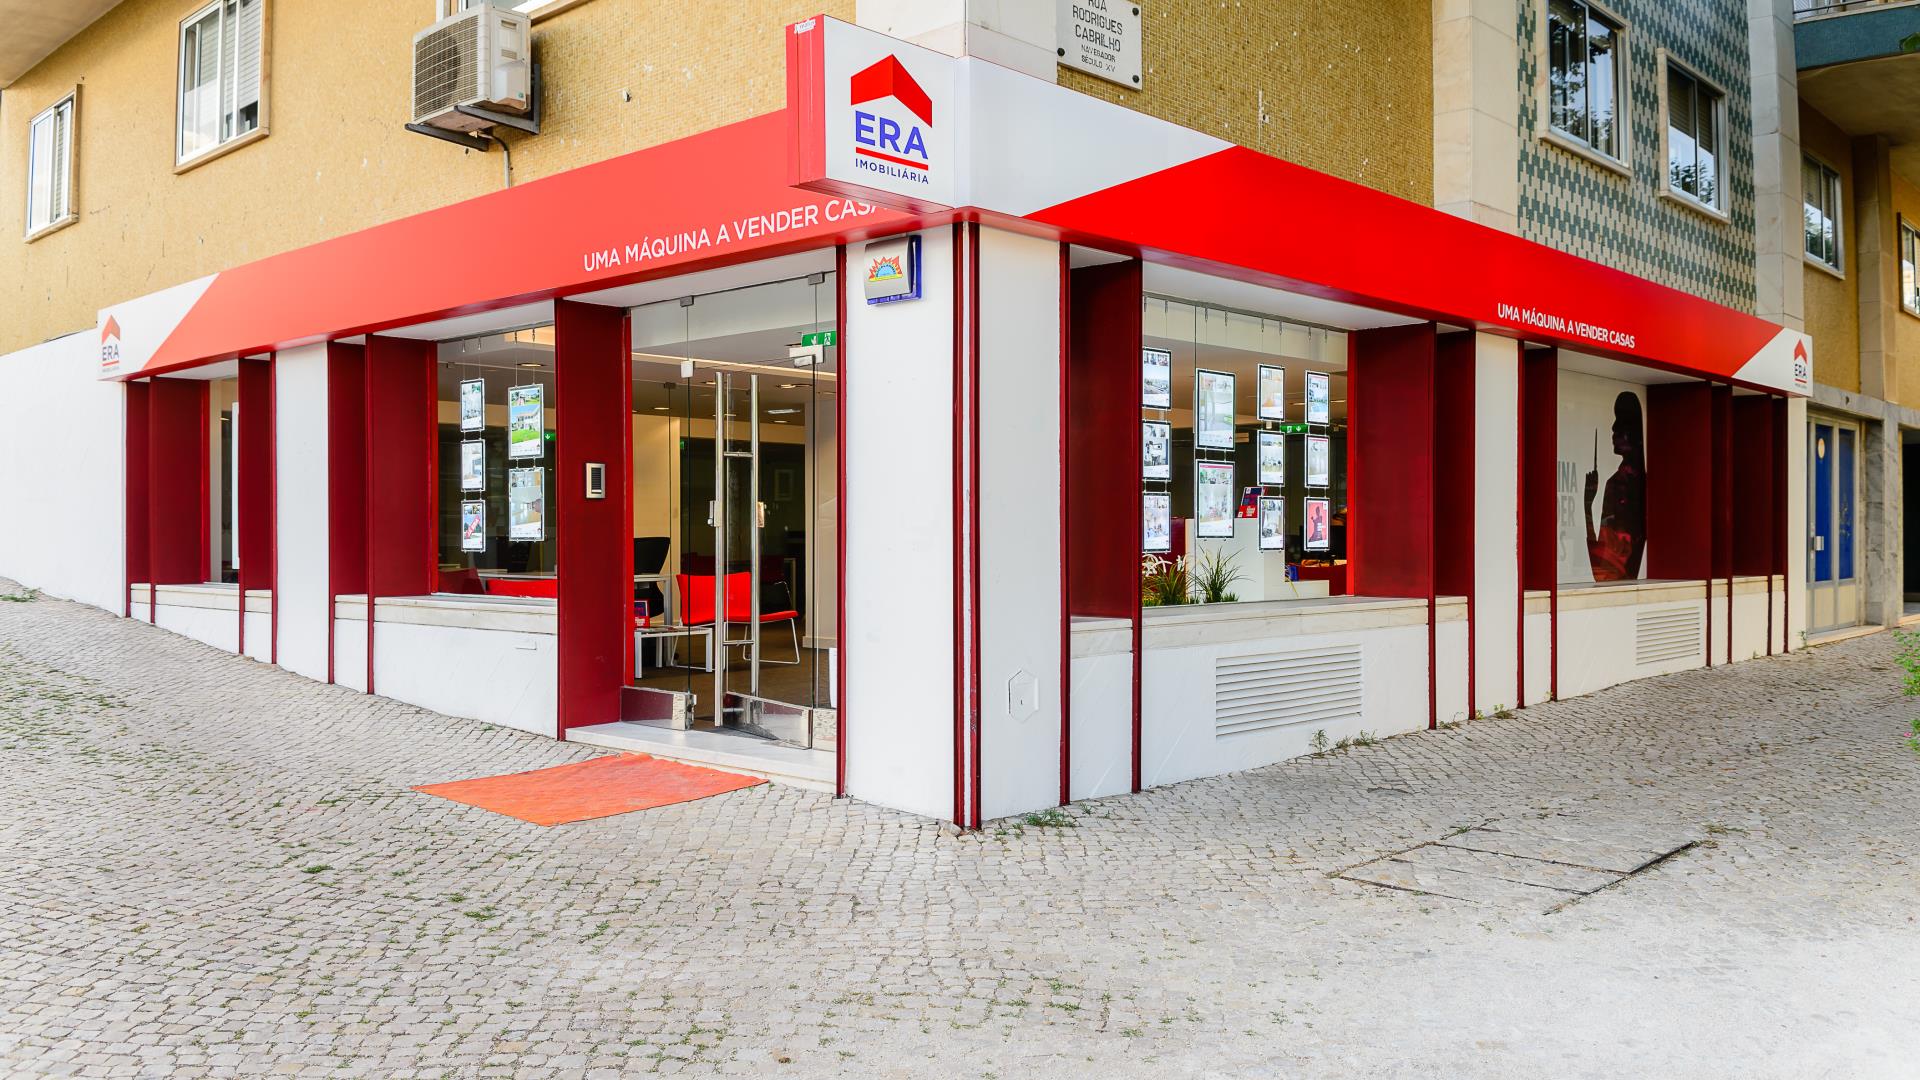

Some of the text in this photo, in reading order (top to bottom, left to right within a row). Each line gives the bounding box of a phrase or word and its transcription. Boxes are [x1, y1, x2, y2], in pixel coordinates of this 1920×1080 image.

[1072, 5, 1123, 35] RODRIGUES
[1088, 0, 1107, 12] RUA
[1075, 24, 1121, 52] CABRILHO
[855, 110, 929, 160] ERA
[855, 158, 929, 185] IMOBILIÁRIA
[584, 199, 887, 272] UMA MÁQUINA A VENDER CAS
[1497, 302, 1636, 349] UMA MÁQUINA A VENDER CASAS
[102, 344, 119, 360] ERA
[1794, 364, 1807, 377] ERA
